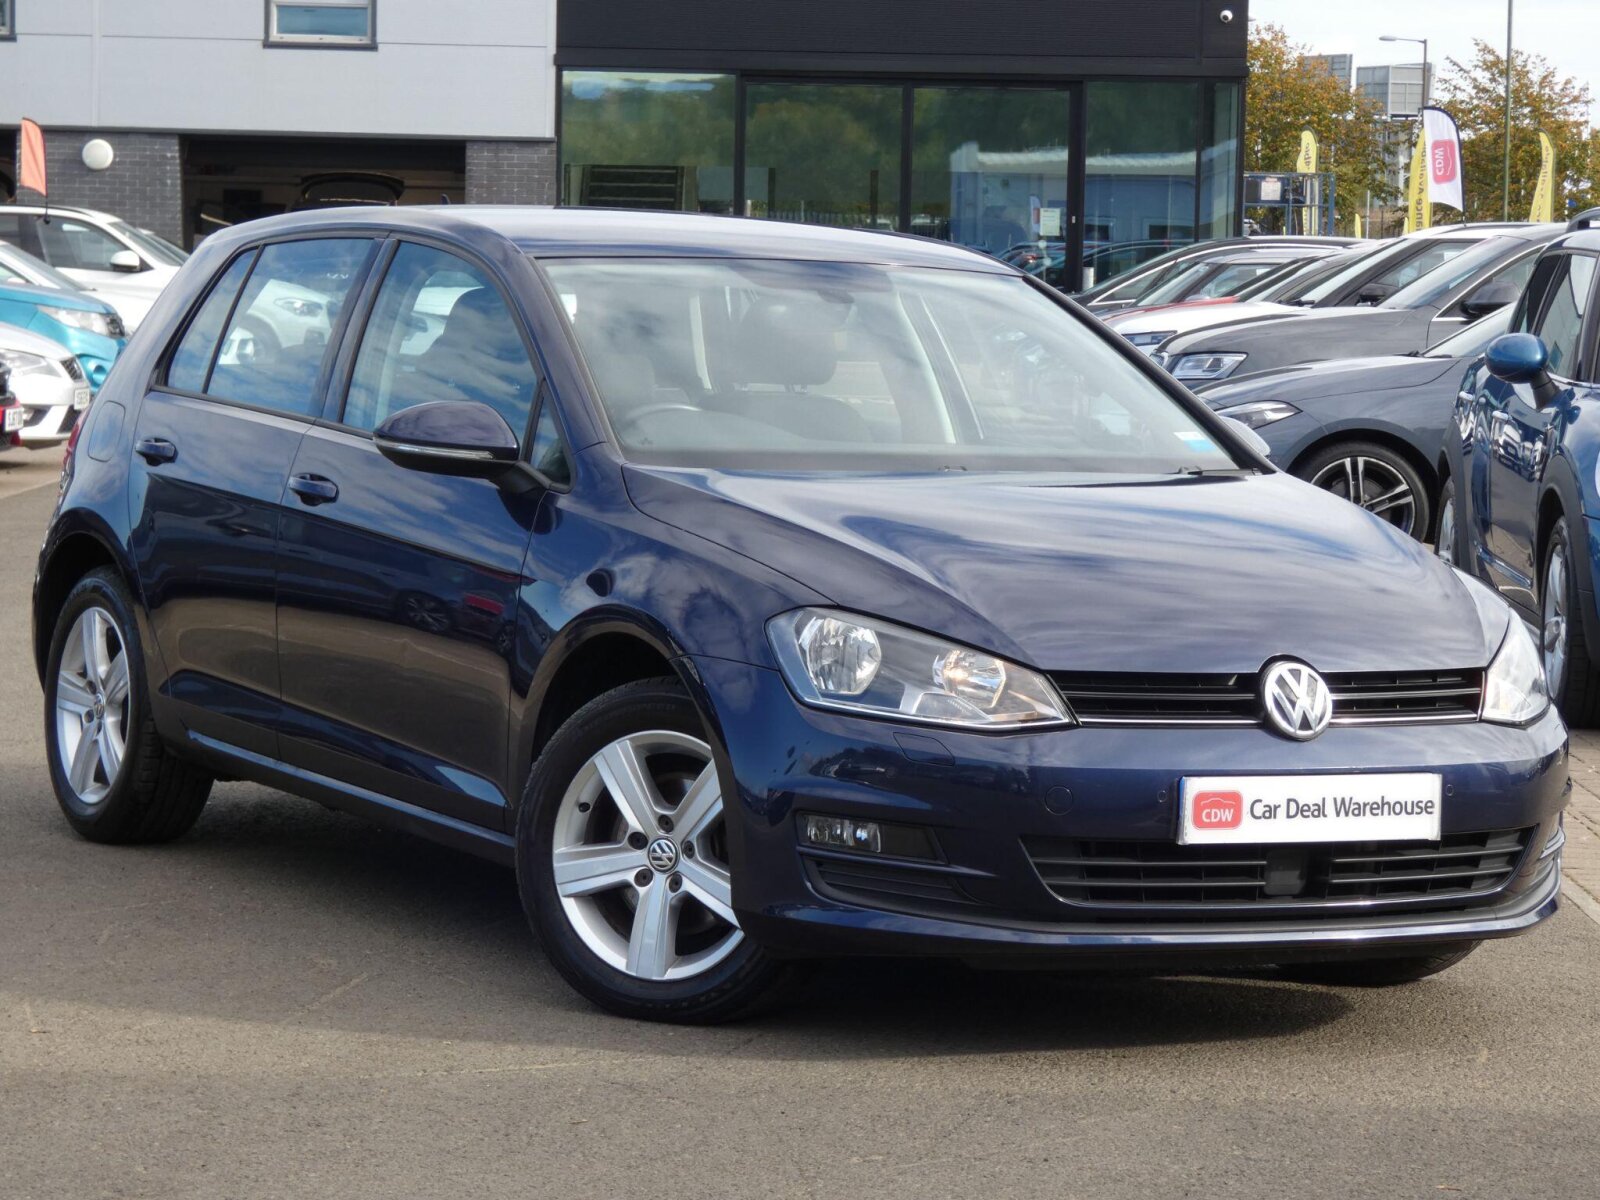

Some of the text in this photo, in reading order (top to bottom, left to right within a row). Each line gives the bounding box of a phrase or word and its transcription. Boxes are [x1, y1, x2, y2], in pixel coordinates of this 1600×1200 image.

[1202, 795, 1435, 823] CDW Car Deal Warehouse
